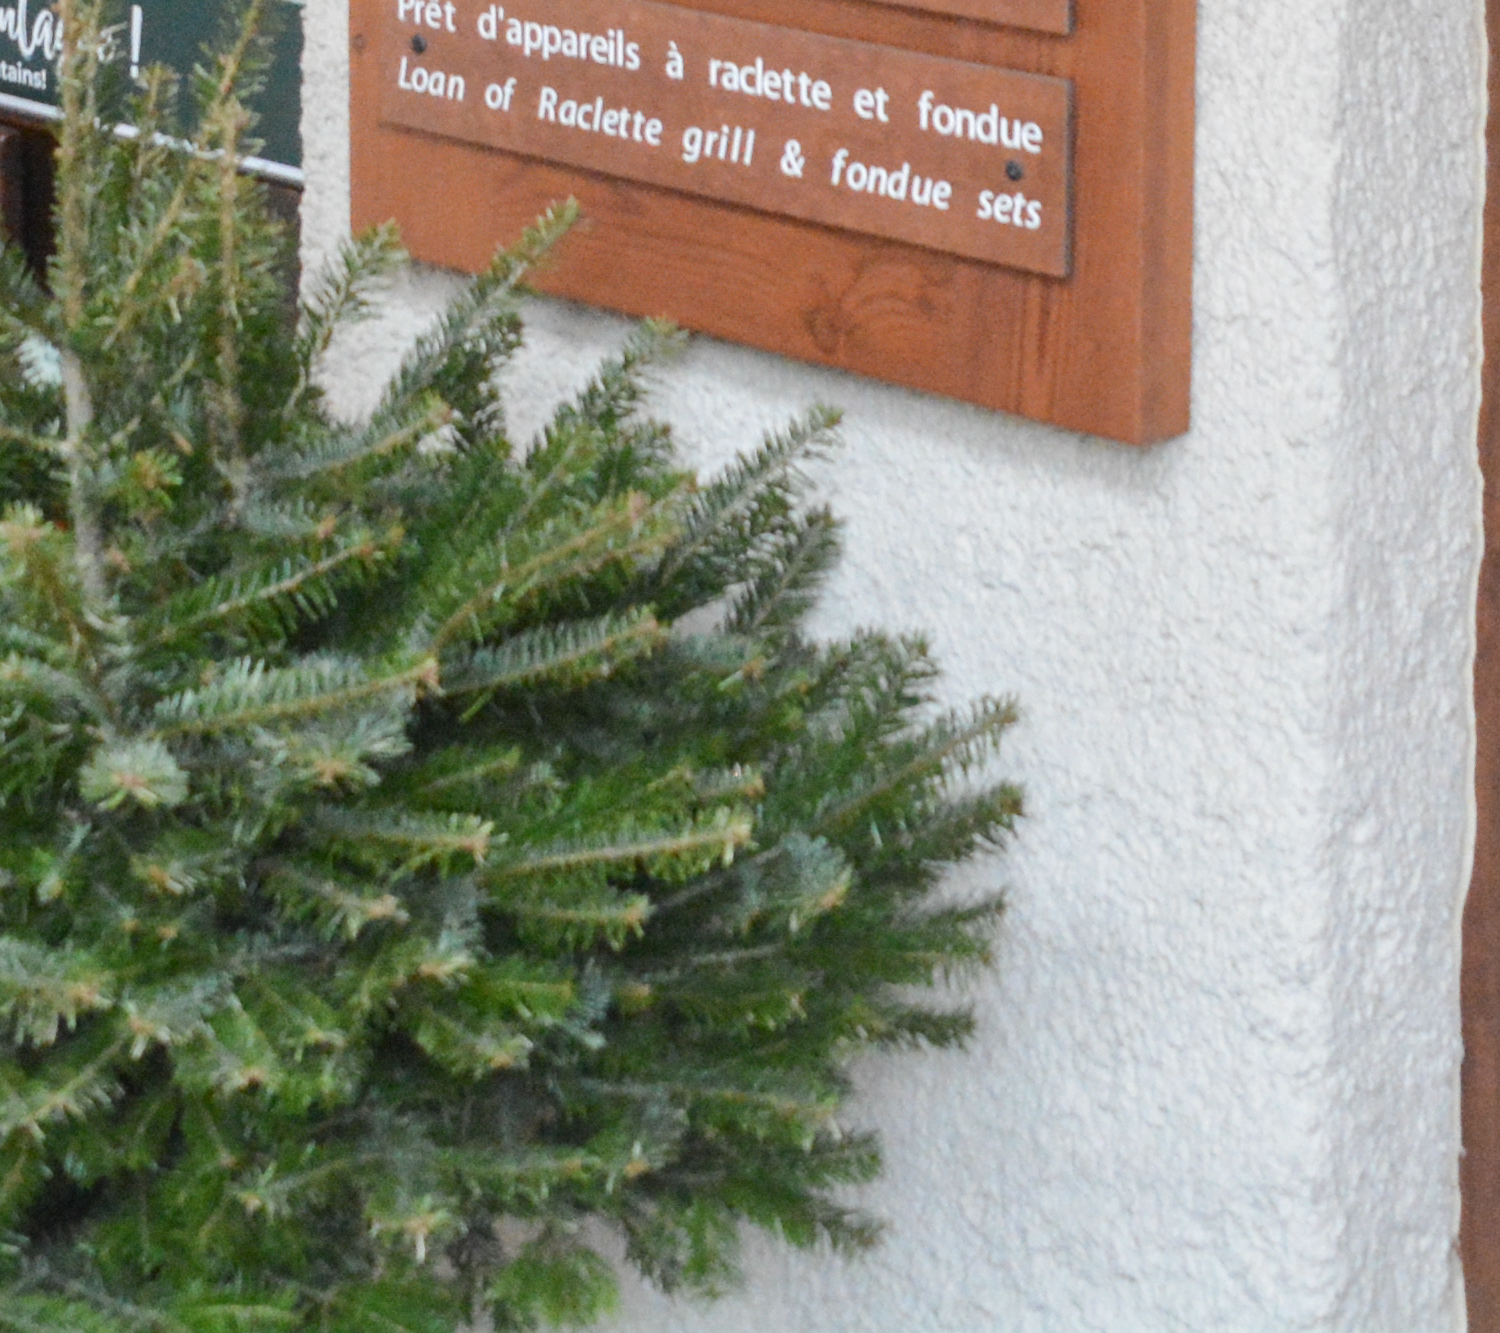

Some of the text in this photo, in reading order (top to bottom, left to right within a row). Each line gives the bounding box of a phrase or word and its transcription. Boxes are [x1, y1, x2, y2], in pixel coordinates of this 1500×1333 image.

[398, 56, 1041, 229] Loan of Raclette grill & fondue sets
[477, 4, 640, 70] d'appareils
[665, 41, 684, 79] à
[709, 57, 832, 110] raclette
[853, 88, 889, 122] et
[918, 90, 1042, 153] fondue
